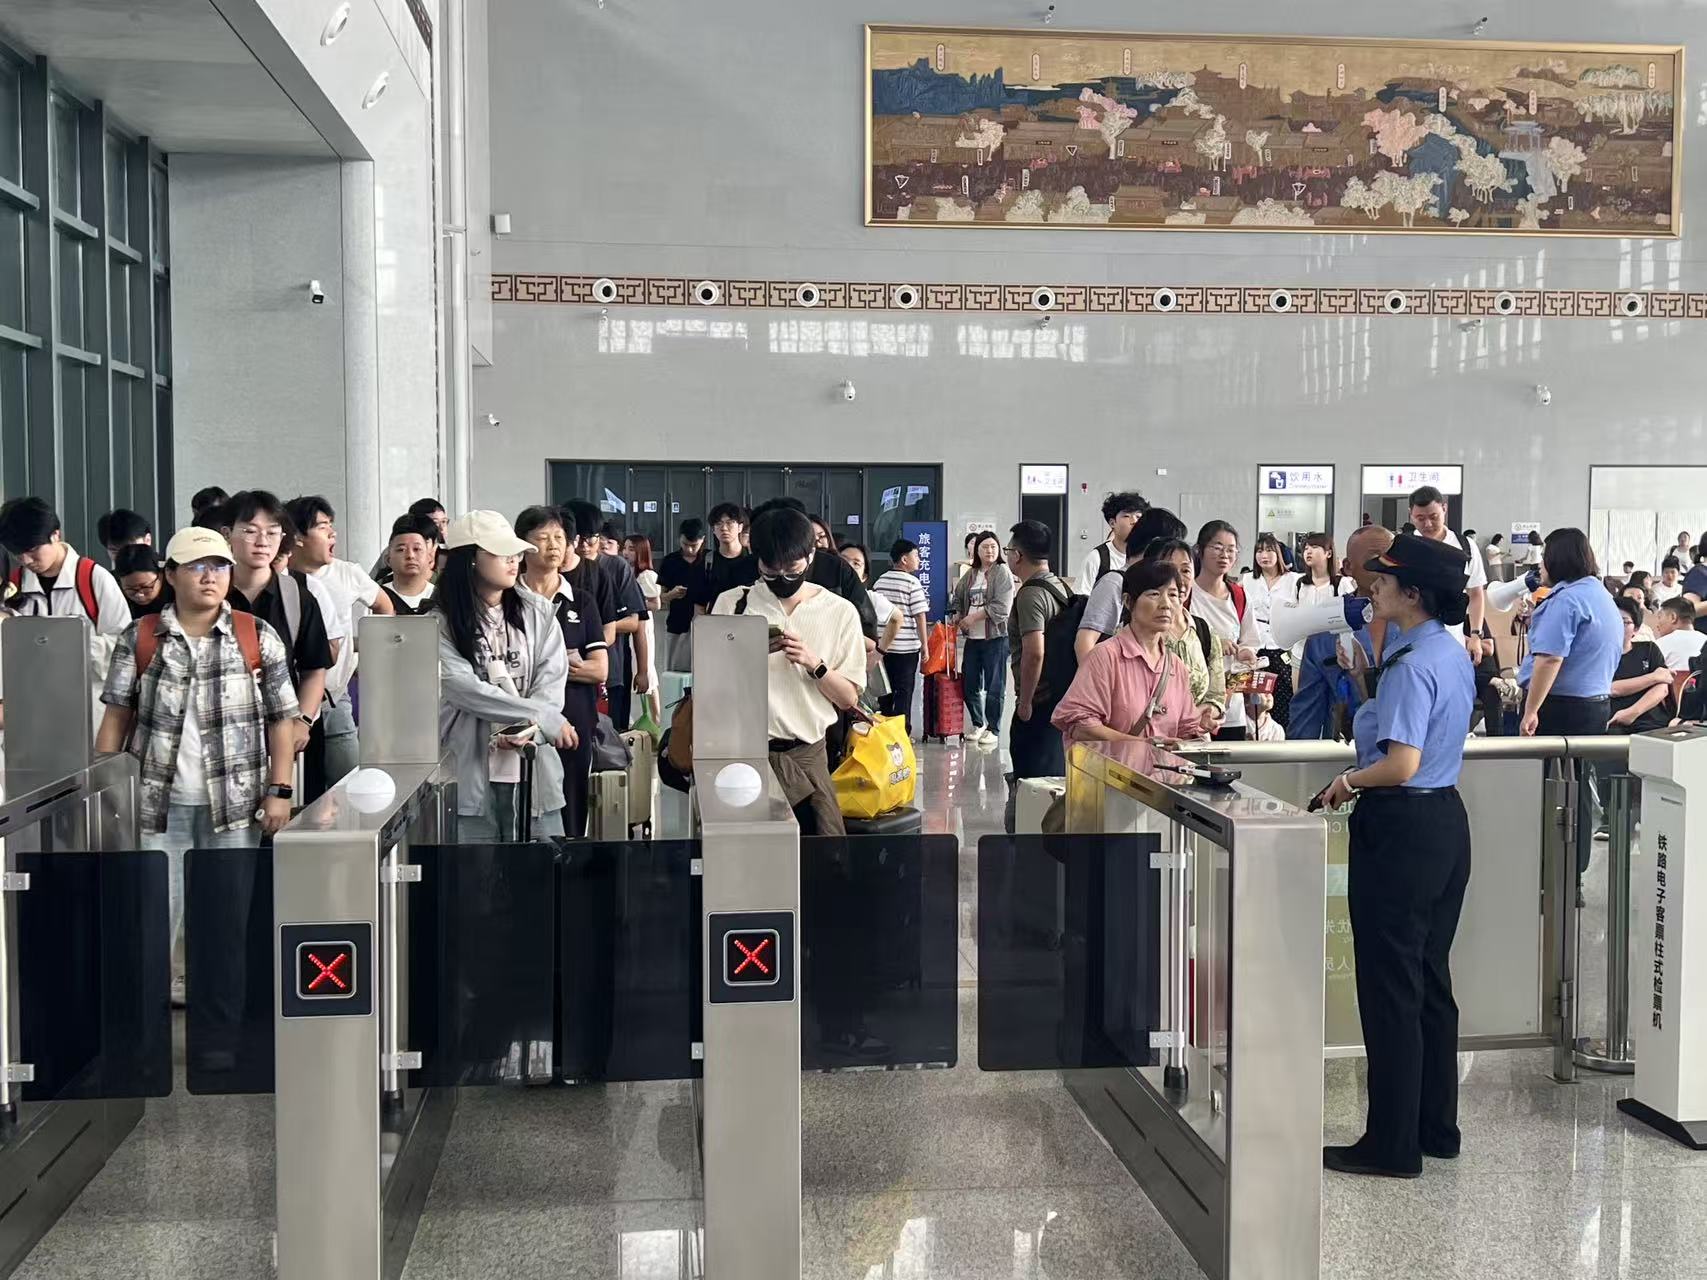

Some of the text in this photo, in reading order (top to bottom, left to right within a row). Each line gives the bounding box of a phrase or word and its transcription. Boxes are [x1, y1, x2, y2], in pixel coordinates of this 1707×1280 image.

[1290, 472, 1322, 482] 饮用水
[1408, 472, 1440, 482] 卫生间
[918, 532, 931, 612] 旅客充电区
[1652, 833, 1667, 1031] 铁路电子客票柱式检票机
